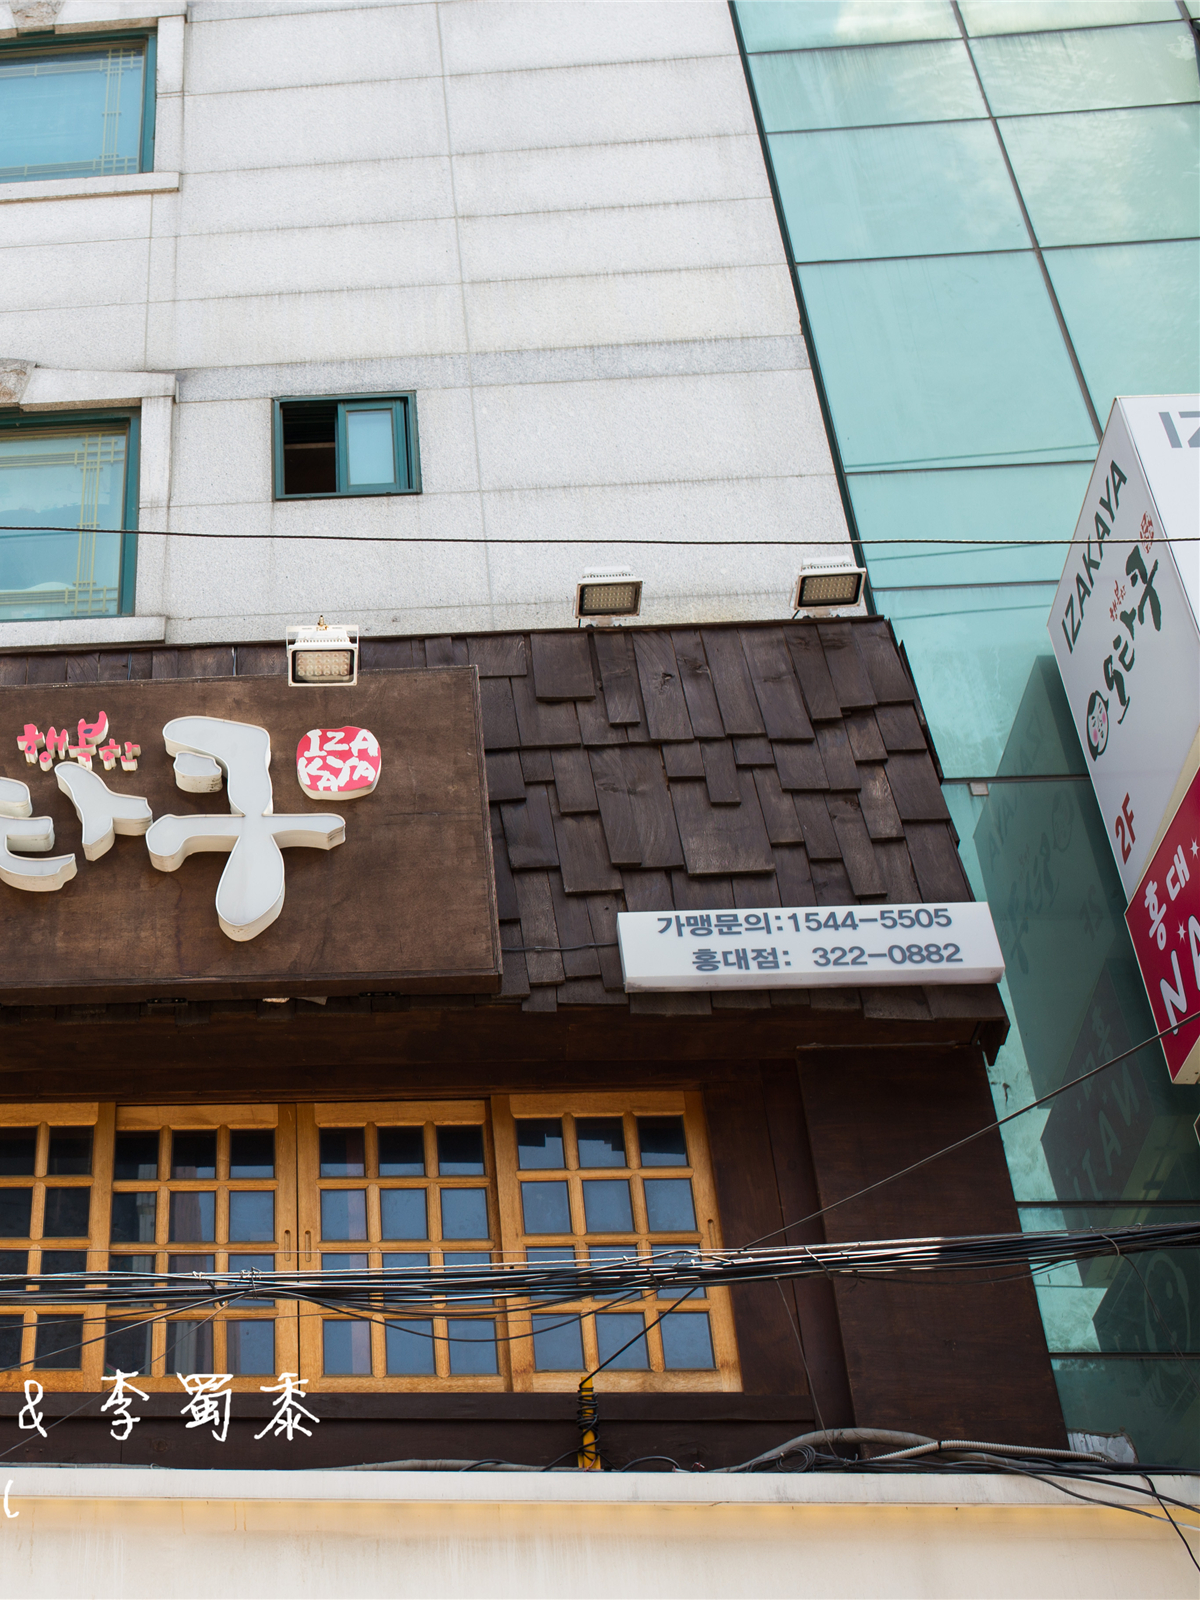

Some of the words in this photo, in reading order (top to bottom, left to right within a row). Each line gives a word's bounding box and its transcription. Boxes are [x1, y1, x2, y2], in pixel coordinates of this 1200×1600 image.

[1061, 459, 1128, 655] IZAKAYA
[1104, 545, 1161, 725] 오타쿠
[16, 711, 141, 771] 행복한
[304, 729, 378, 758] IZA
[1115, 792, 1136, 865] 2F
[1144, 845, 1190, 951] 홍대
[692, 947, 792, 972] 홍대점:
[811, 943, 964, 968] 322-0882
